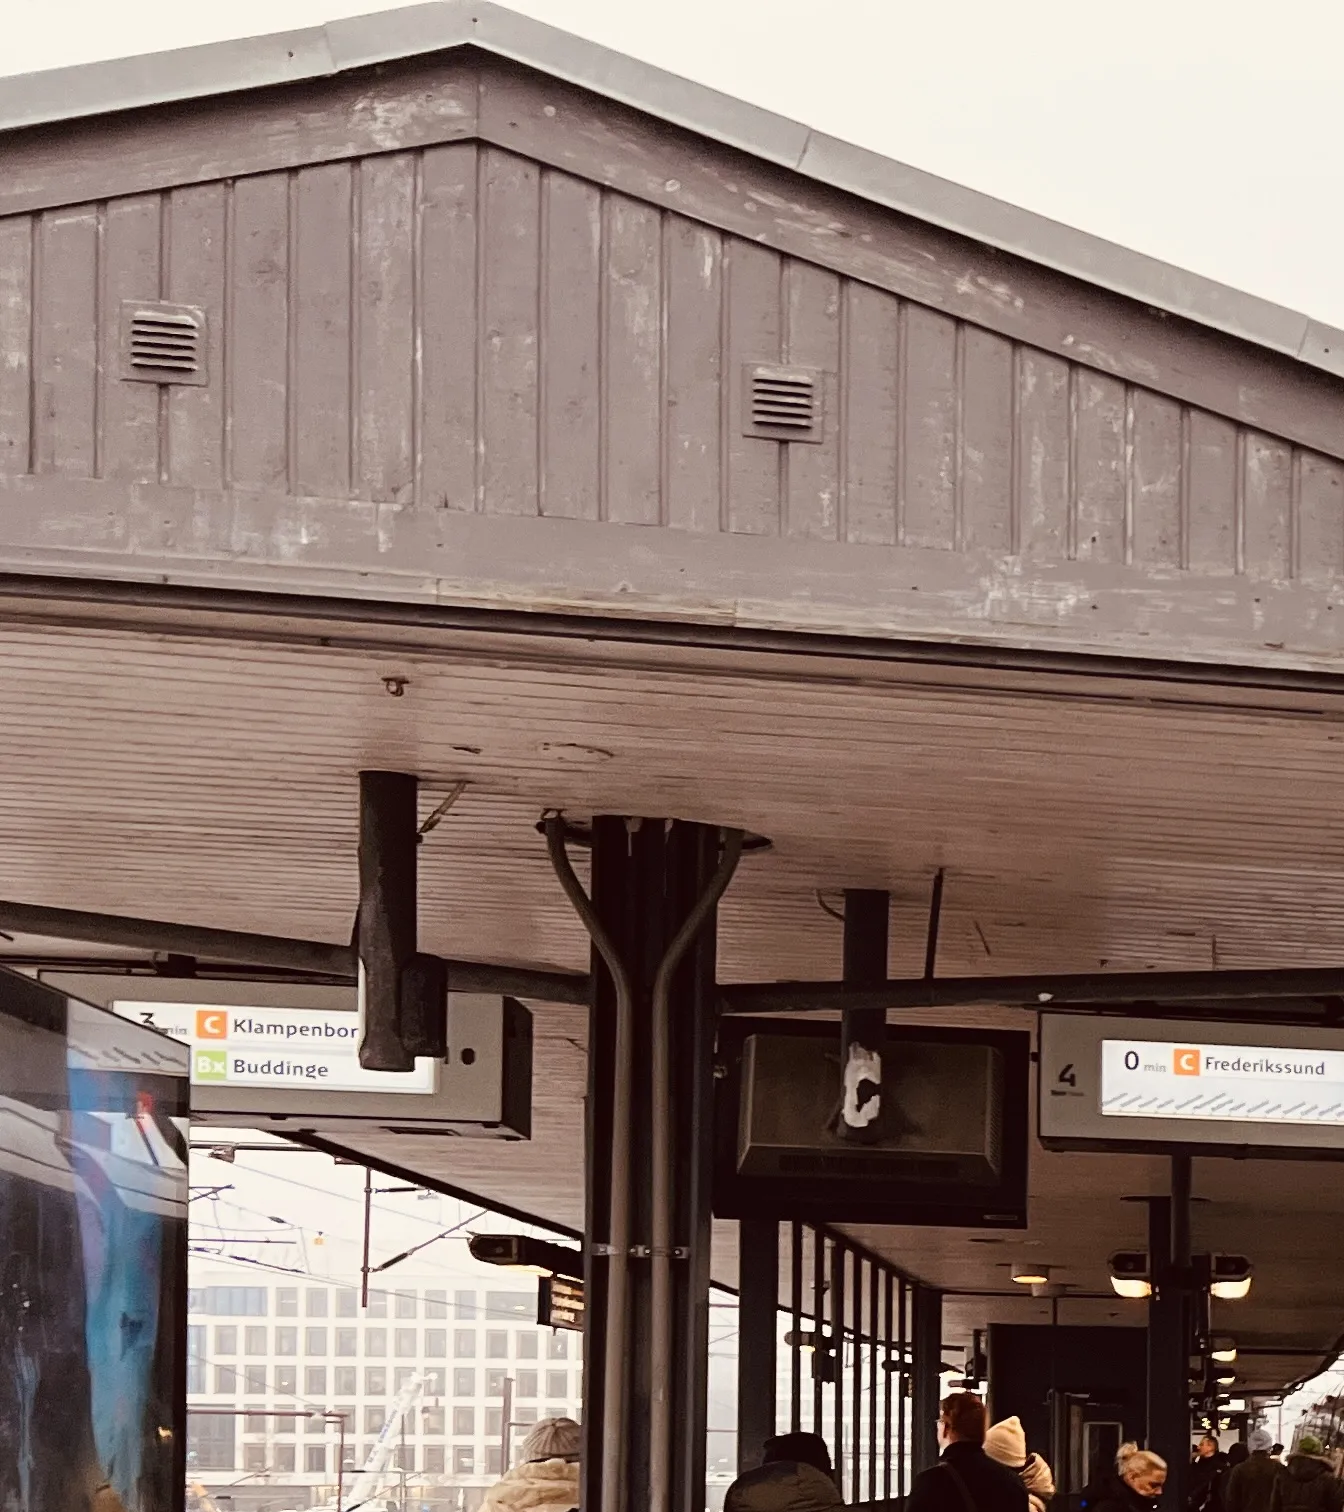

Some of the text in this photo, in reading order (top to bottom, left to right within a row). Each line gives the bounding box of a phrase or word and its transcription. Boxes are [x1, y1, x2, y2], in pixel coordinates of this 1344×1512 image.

[233, 1018, 359, 1039] Klampenbor
[198, 1056, 329, 1079] Bx Buddinge
[1058, 1063, 1076, 1087] 4
[1124, 1051, 1140, 1071] 0
[1143, 1061, 1167, 1073] min
[1205, 1056, 1326, 1076] Frederikssund
